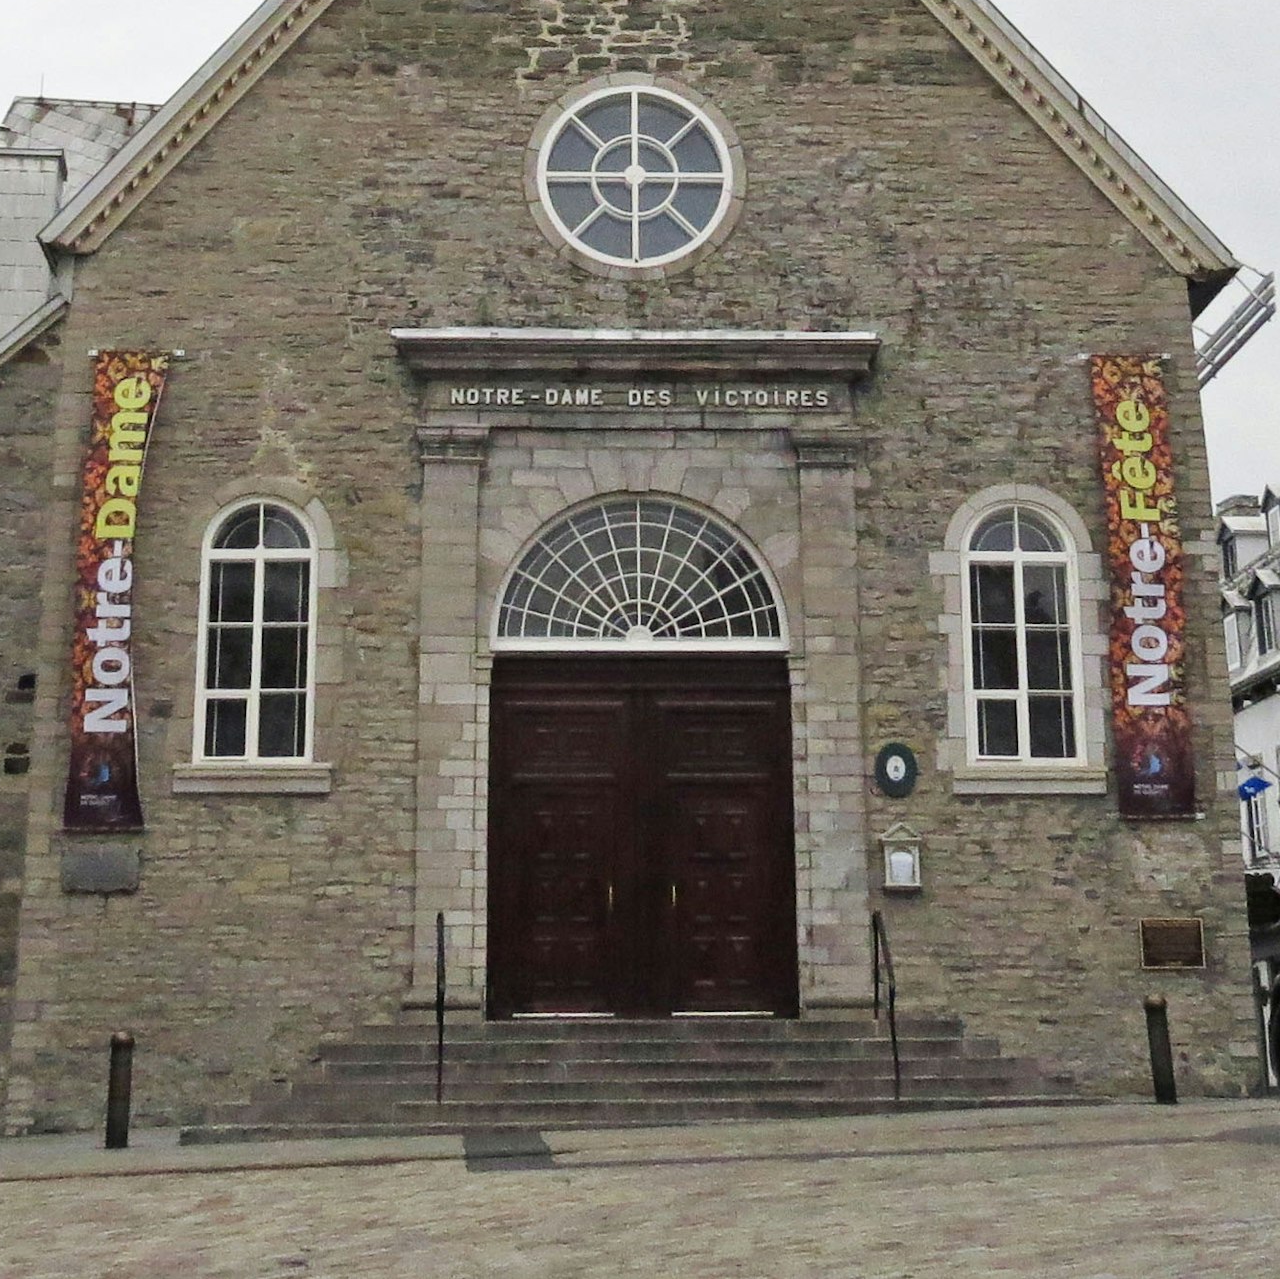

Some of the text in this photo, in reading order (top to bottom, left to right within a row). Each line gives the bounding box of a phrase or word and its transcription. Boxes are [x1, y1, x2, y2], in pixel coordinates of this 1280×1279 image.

[450, 388, 604, 405] NOTRE-DAME
[628, 389, 671, 406] DES
[84, 377, 152, 734] Notre-Dame
[1115, 400, 1172, 707] Notre-Fête
